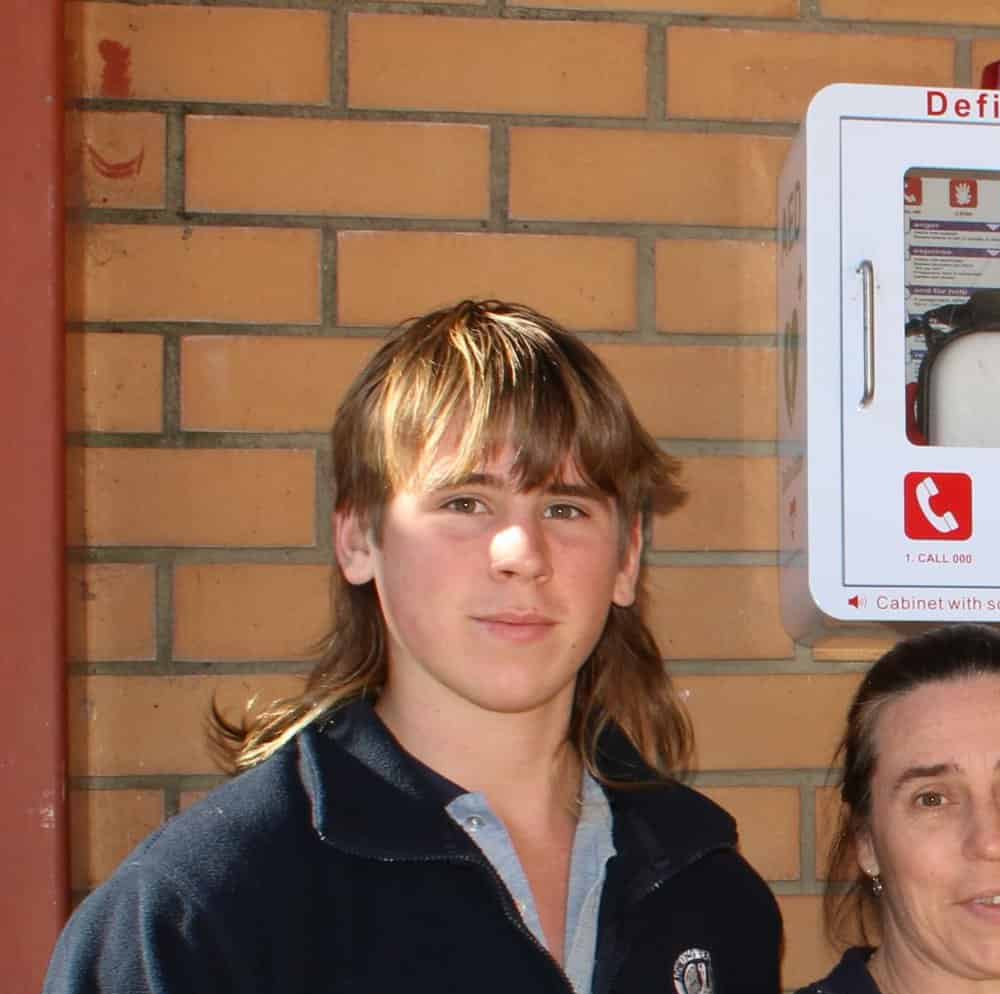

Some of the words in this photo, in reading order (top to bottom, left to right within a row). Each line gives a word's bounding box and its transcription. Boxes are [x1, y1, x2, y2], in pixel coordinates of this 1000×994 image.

[905, 554, 915, 563] 1.
[918, 553, 948, 564] CALL
[952, 554, 972, 565] 000
[876, 596, 943, 611] Cabinet
[948, 598, 981, 610] with
